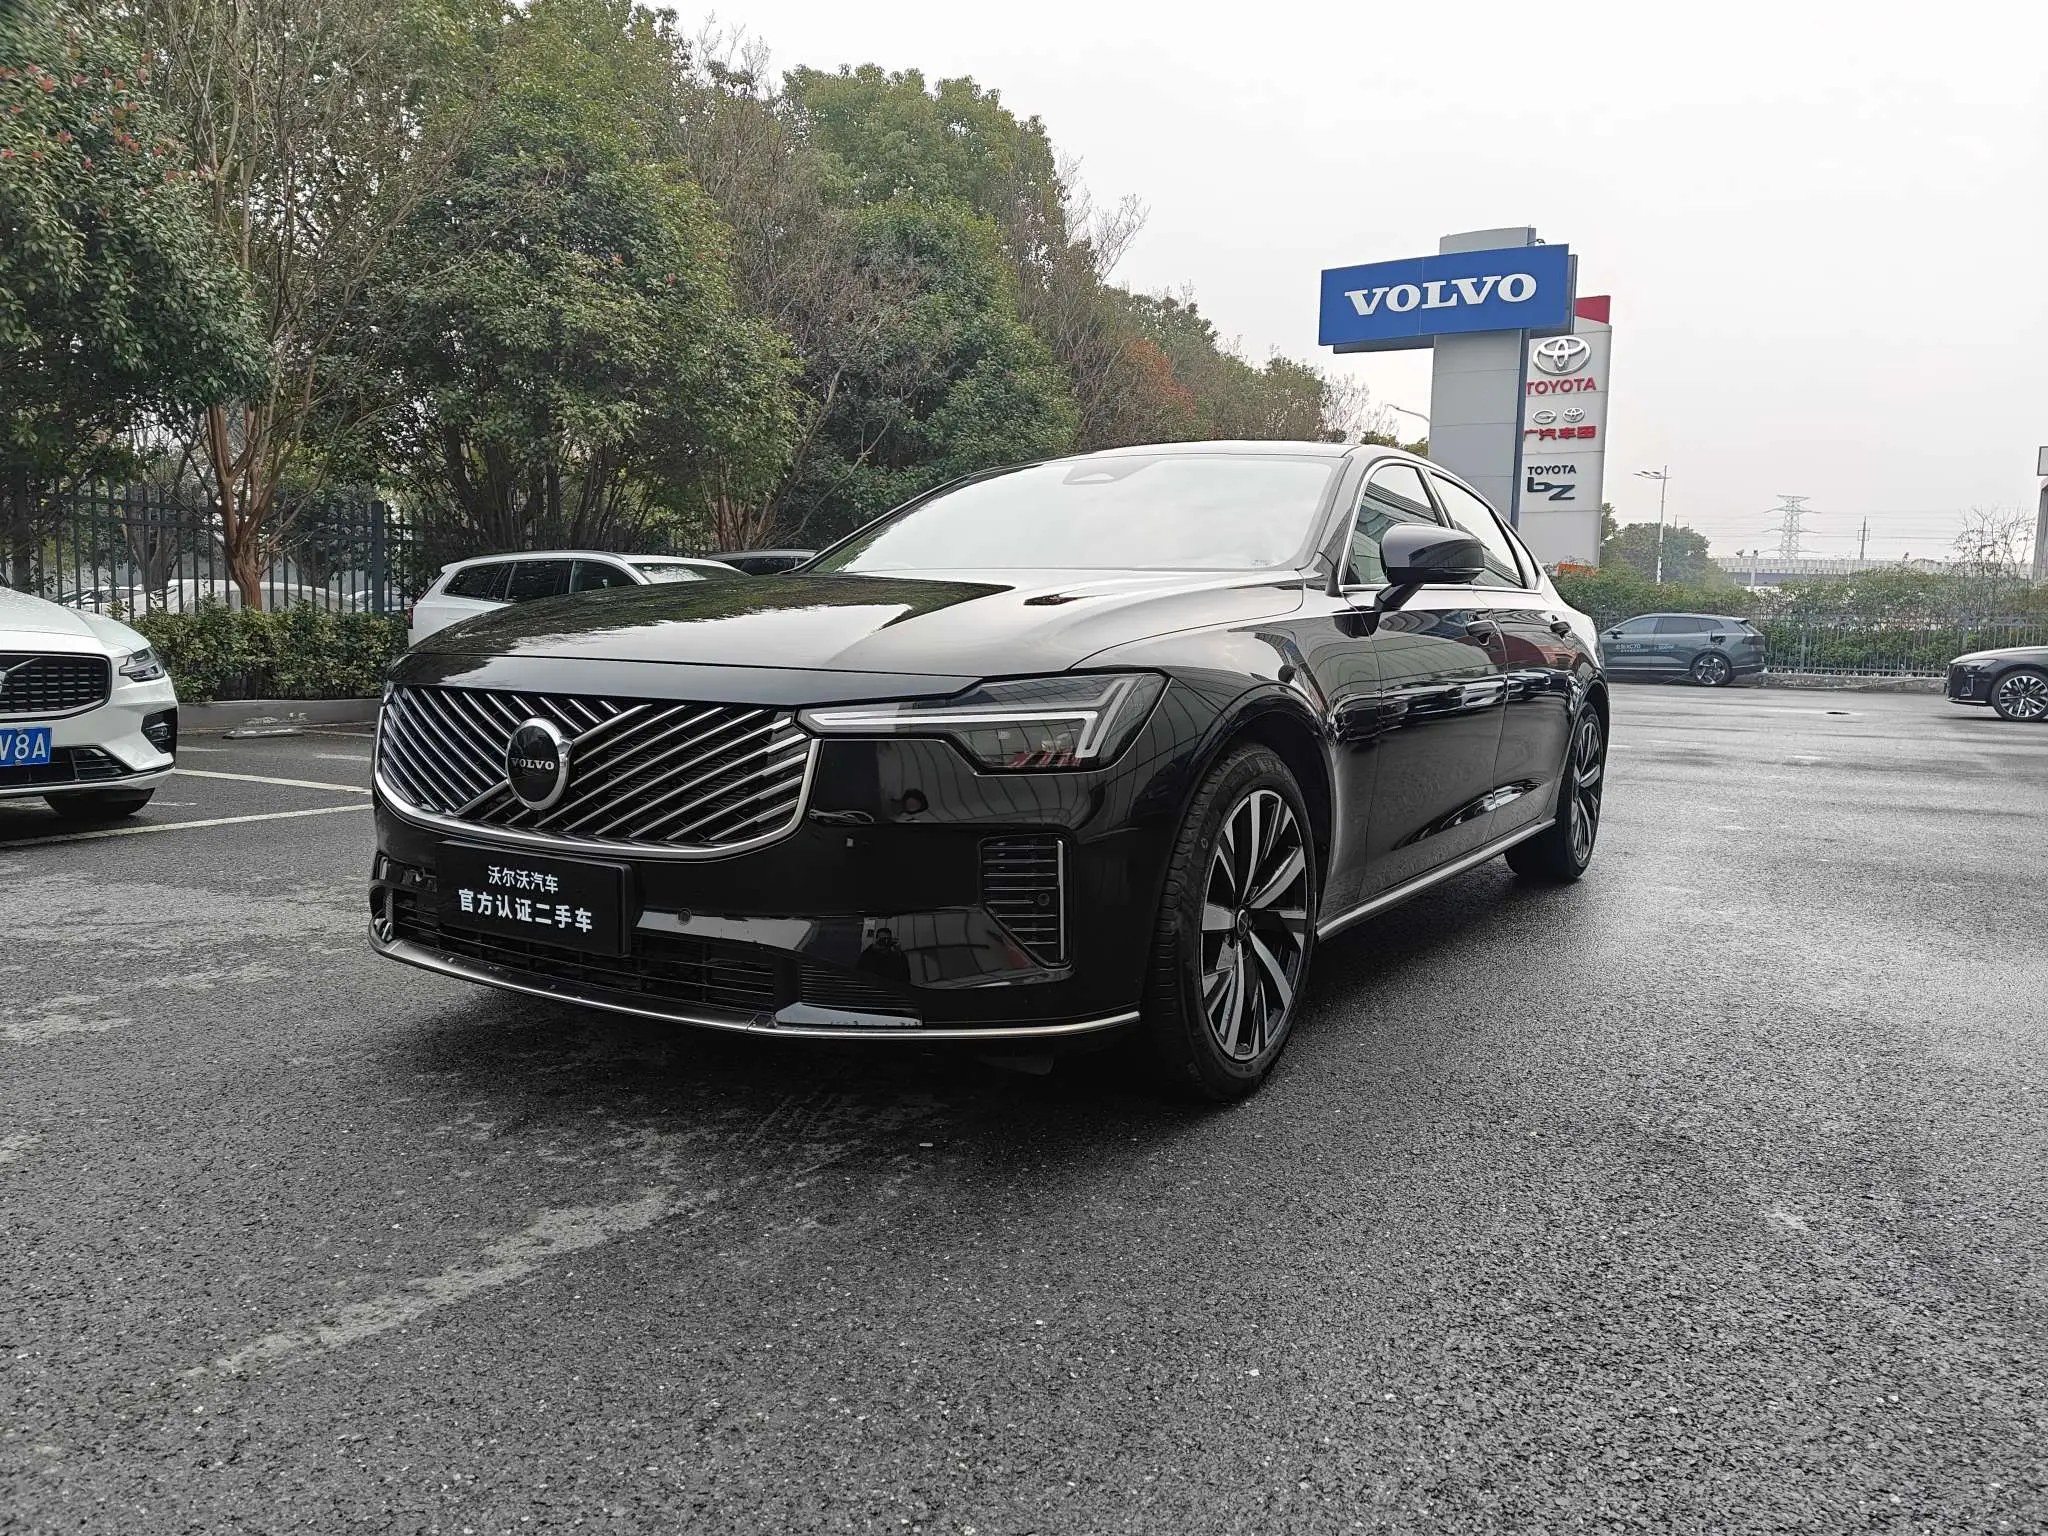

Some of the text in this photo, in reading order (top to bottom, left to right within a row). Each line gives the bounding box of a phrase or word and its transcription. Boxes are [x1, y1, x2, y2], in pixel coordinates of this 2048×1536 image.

[1344, 273, 1537, 316] VOLVO
[1526, 377, 1597, 395] TOYOTA
[1527, 464, 1577, 476] TOYOTA
[510, 757, 555, 770] VOLVO
[487, 865, 559, 894] 沃尔沃汽车
[458, 888, 593, 933] 官方认证二手车
